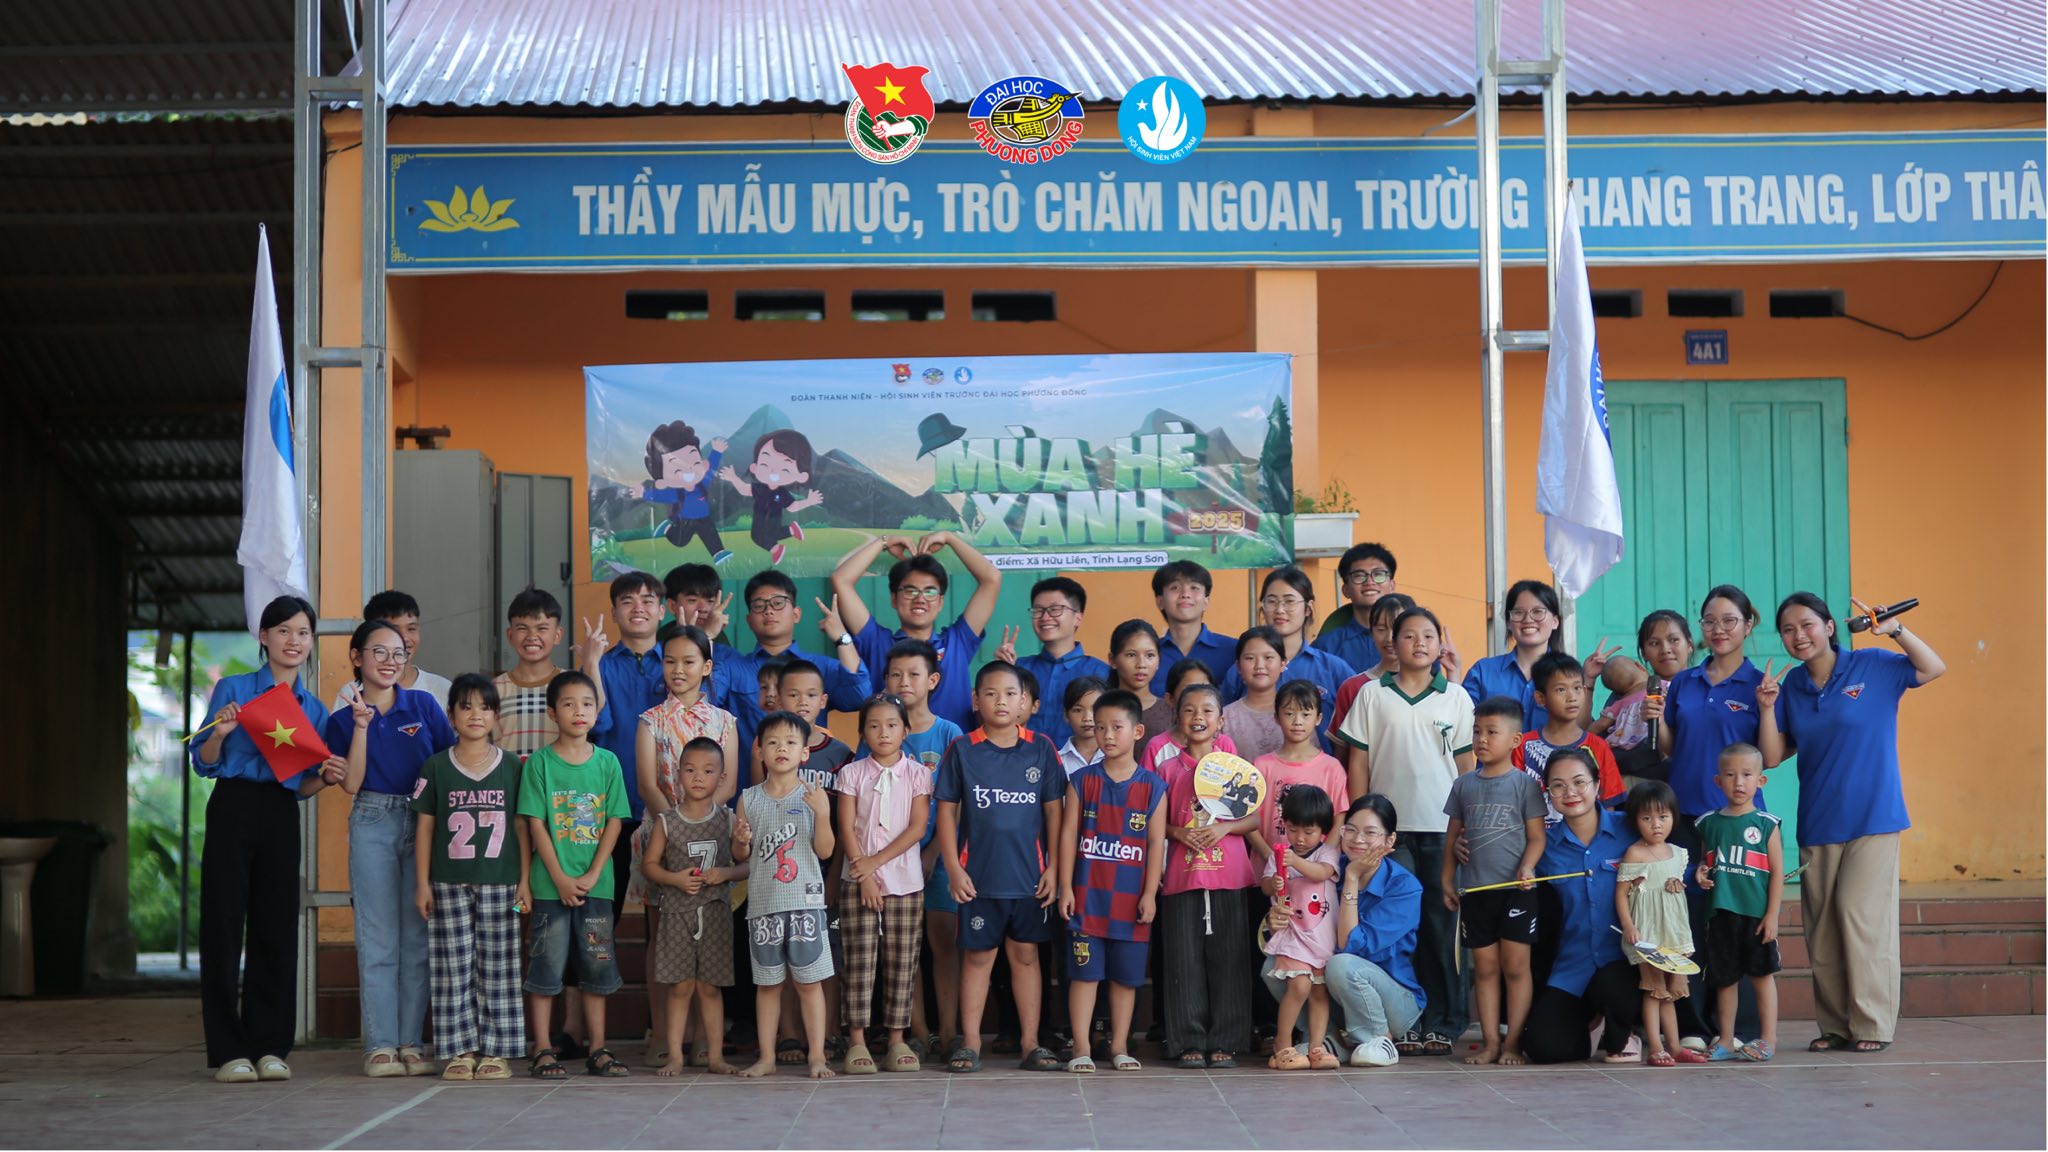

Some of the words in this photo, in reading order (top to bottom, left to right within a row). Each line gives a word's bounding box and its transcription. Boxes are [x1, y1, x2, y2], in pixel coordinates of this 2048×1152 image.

[573, 166, 681, 236] THẦY
[699, 163, 797, 235] MẪU
[811, 177, 924, 244] MỰC,
[937, 170, 1021, 233] TRÒ
[1035, 171, 1163, 232] CHĂM
[1178, 180, 1343, 238] NGOAN,
[1545, 175, 1693, 227] HANG
[1704, 172, 1858, 230] TRANG,
[1872, 162, 1952, 224] LỚP
[1692, 341, 1722, 360] 4A1
[819, 393, 849, 401] THANH
[851, 392, 872, 400] NIÊN
[922, 390, 942, 399] VIÊN
[934, 424, 1098, 493] MÙA
[1114, 420, 1208, 489] HÈ
[969, 487, 1173, 547] XANH
[1188, 509, 1246, 532] 2025
[995, 555, 1025, 567] điểm:
[1027, 556, 1040, 566] Xã
[1042, 555, 1063, 566] Hữu
[1066, 555, 1090, 566] Liên,
[1117, 555, 1143, 566] Lạng
[1145, 554, 1164, 564] Sơn
[448, 789, 505, 808] STANCE
[992, 788, 1036, 804] Tezos
[447, 811, 506, 860] 27
[759, 822, 798, 862] BAD
[1079, 835, 1144, 862] akuten
[687, 839, 719, 875] 7
[772, 839, 799, 884] 5
